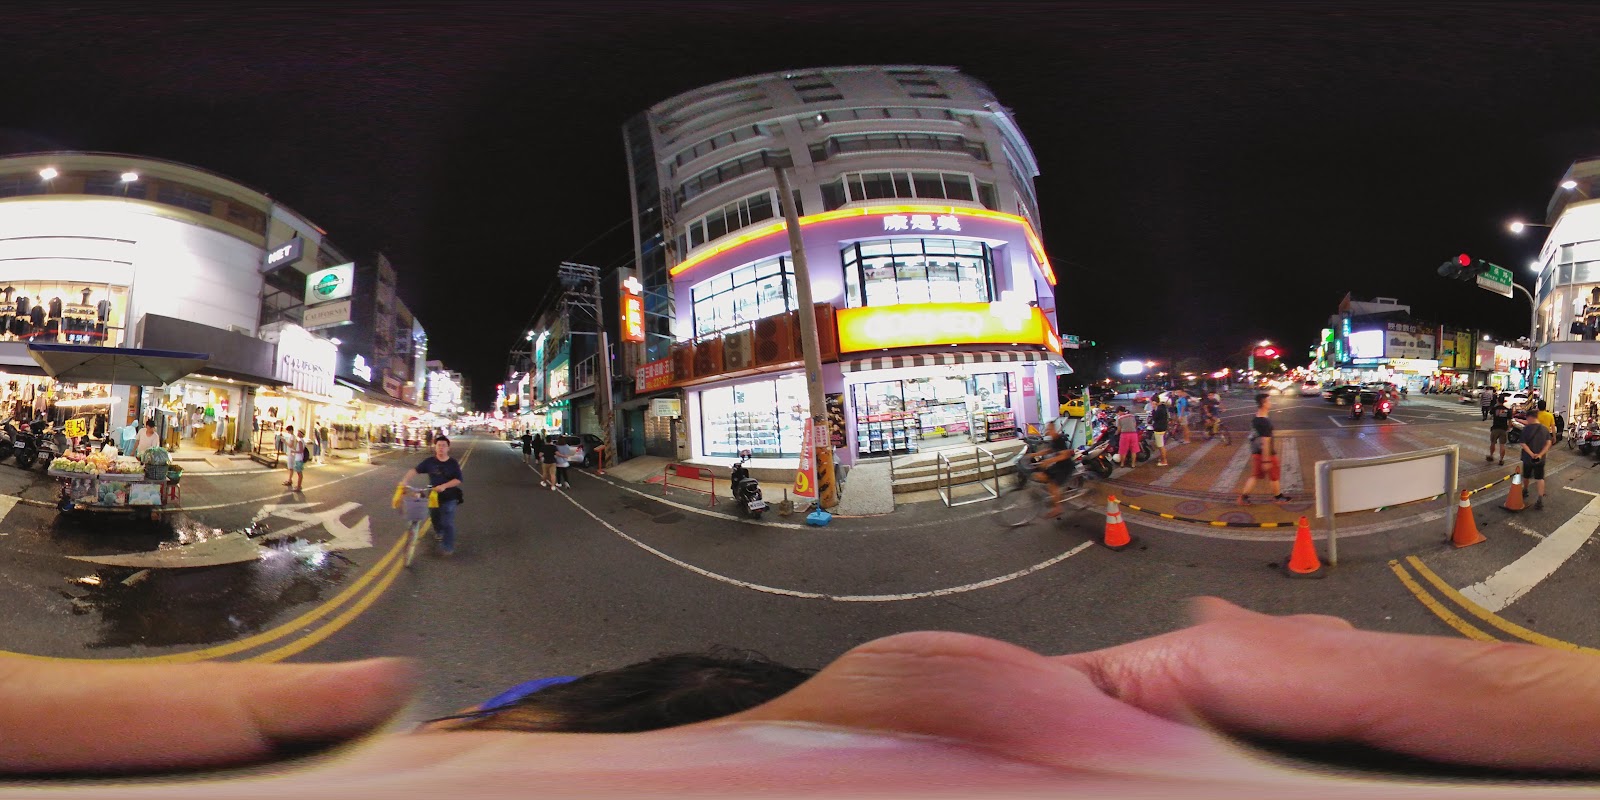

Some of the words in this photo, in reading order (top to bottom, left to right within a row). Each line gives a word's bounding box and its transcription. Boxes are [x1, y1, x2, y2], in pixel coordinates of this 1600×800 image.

[883, 214, 961, 232] 康是美
[268, 245, 292, 264] NET
[305, 307, 348, 321] CALIFORNIA
[284, 354, 331, 376] CALIFORNA
